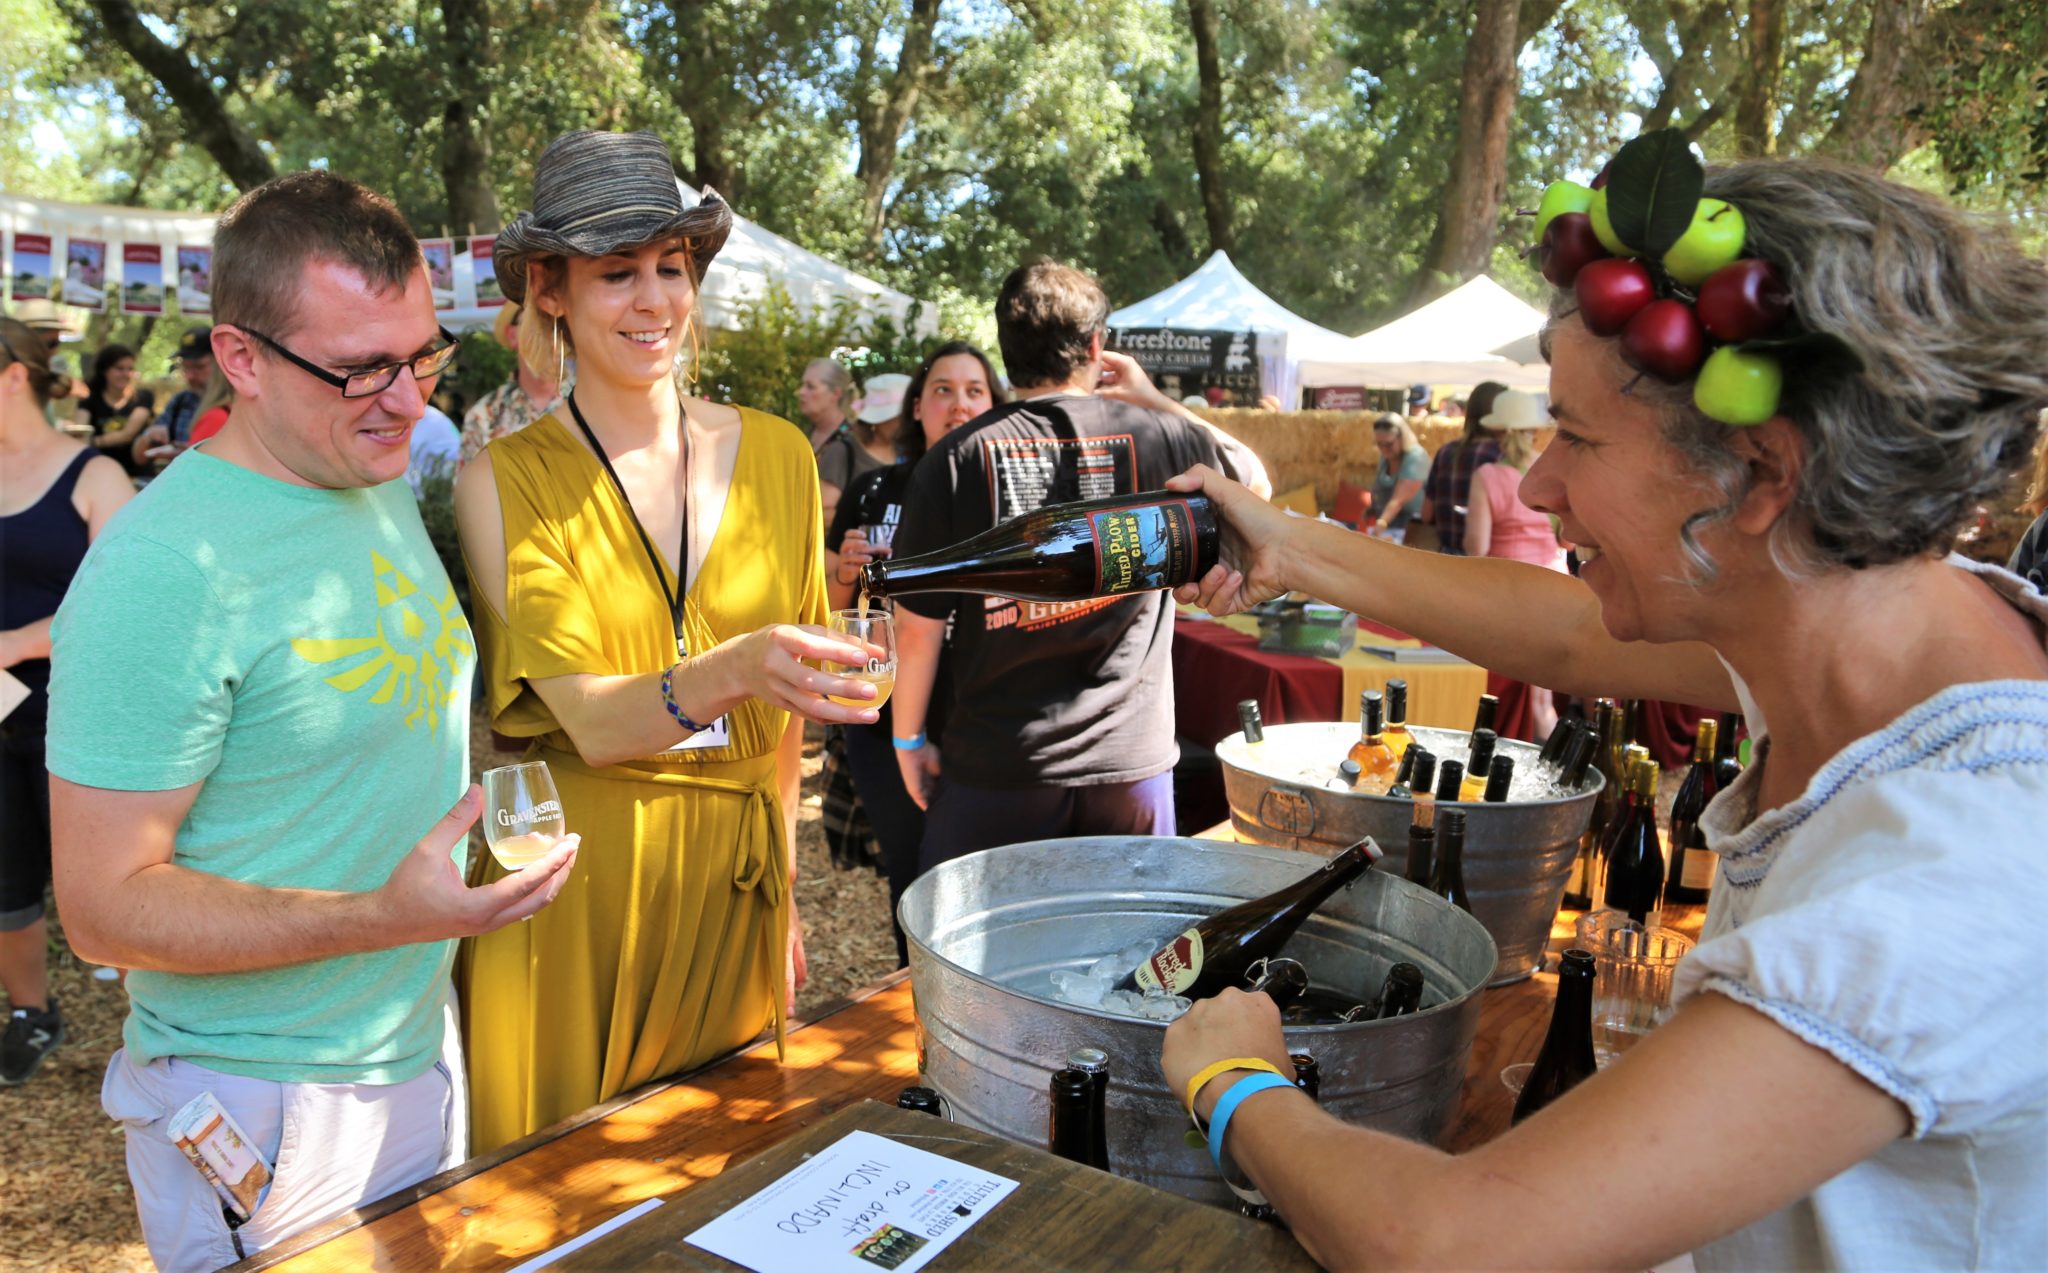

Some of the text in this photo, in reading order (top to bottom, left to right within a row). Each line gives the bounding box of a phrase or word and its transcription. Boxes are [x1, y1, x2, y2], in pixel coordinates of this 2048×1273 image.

[1115, 328, 1212, 351] Freestone
[1125, 517, 1141, 558] CIDER
[1108, 517, 1132, 592] TILTED PLOW
[985, 605, 1018, 630] 2010
[533, 815, 552, 824] APPLE
[777, 1160, 891, 1234] INCLINADO
[885, 1180, 911, 1198] on
[963, 1180, 1001, 1207] TILTED
[841, 1201, 889, 1237] draft
[926, 1215, 958, 1237] SHED
